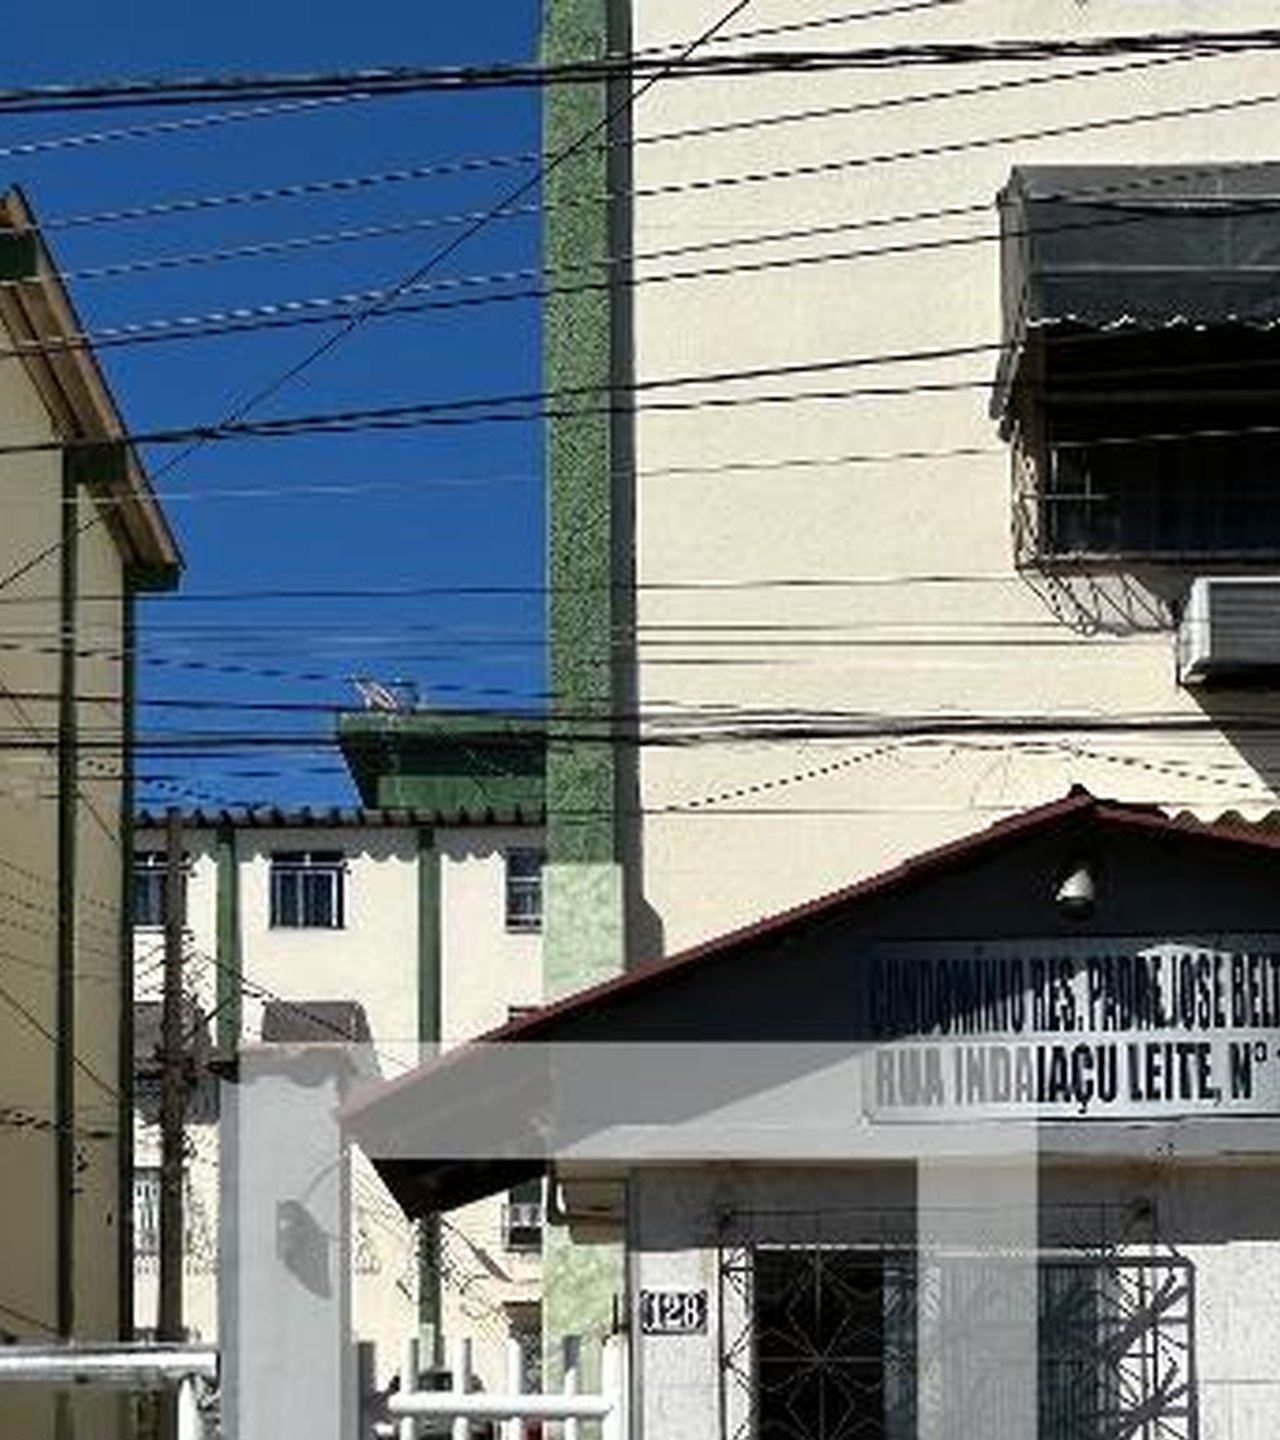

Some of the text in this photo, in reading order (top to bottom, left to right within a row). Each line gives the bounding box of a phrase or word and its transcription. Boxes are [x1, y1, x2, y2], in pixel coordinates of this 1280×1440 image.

[1029, 956, 1084, 1033] RES.
[876, 1049, 943, 1107] RUA
[954, 1044, 1117, 1113] INDAIAÇU
[1129, 1044, 1222, 1106] LEITE,
[651, 1293, 699, 1328] 128
